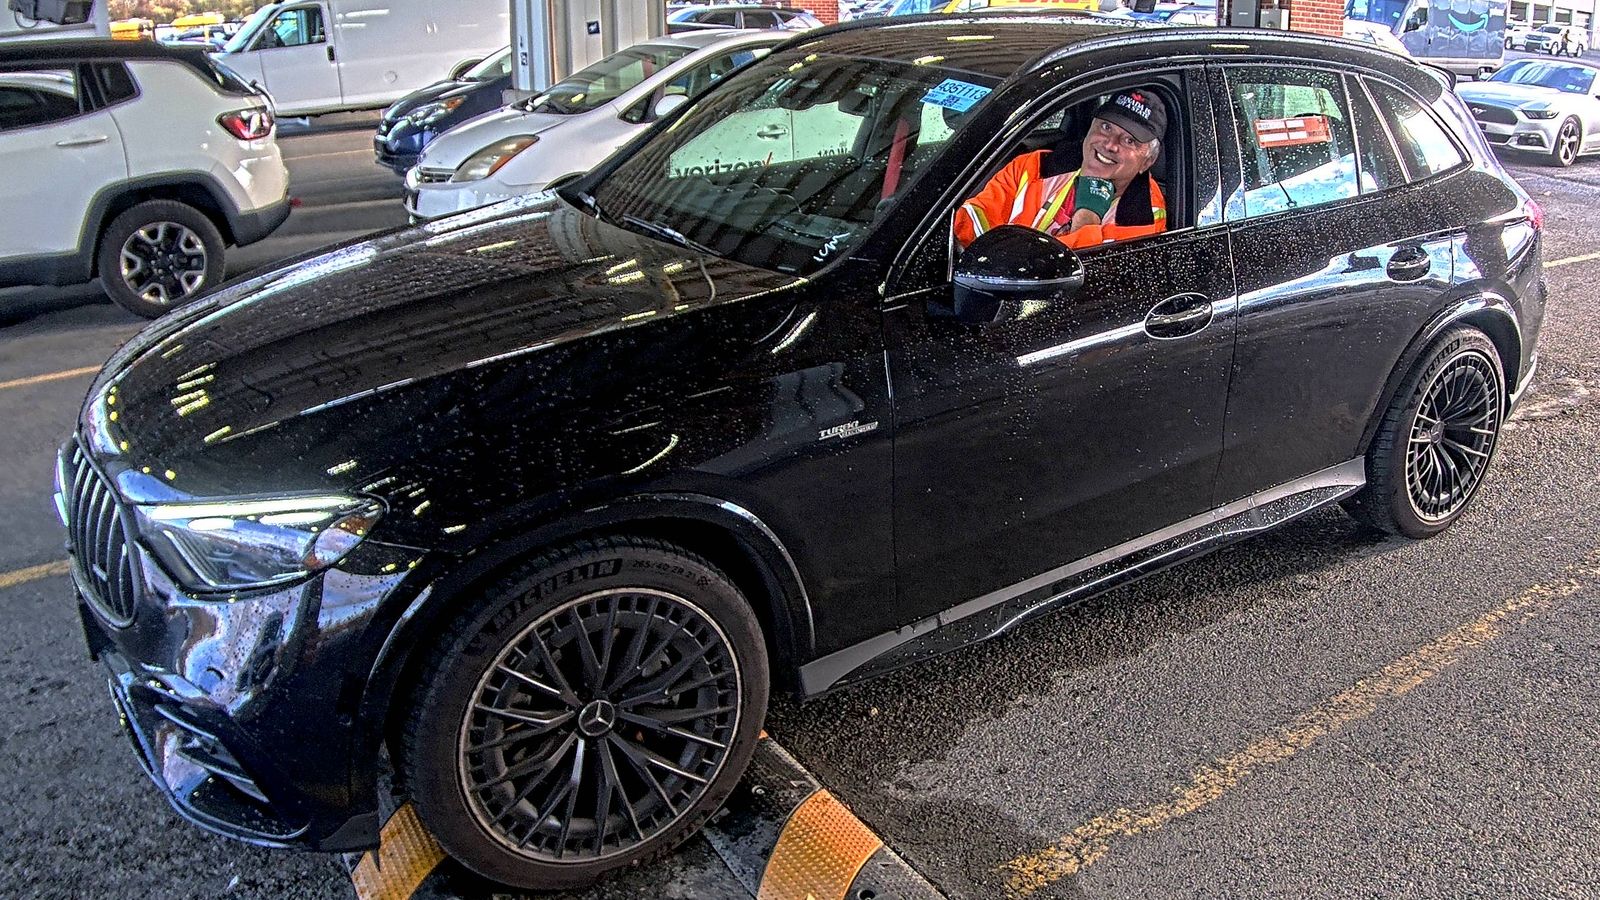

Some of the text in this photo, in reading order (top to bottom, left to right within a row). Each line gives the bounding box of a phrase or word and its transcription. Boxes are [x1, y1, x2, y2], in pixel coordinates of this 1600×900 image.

[1117, 94, 1144, 111] CANADA
[819, 420, 859, 437] TURBO
[492, 560, 616, 630] MICHELIN
